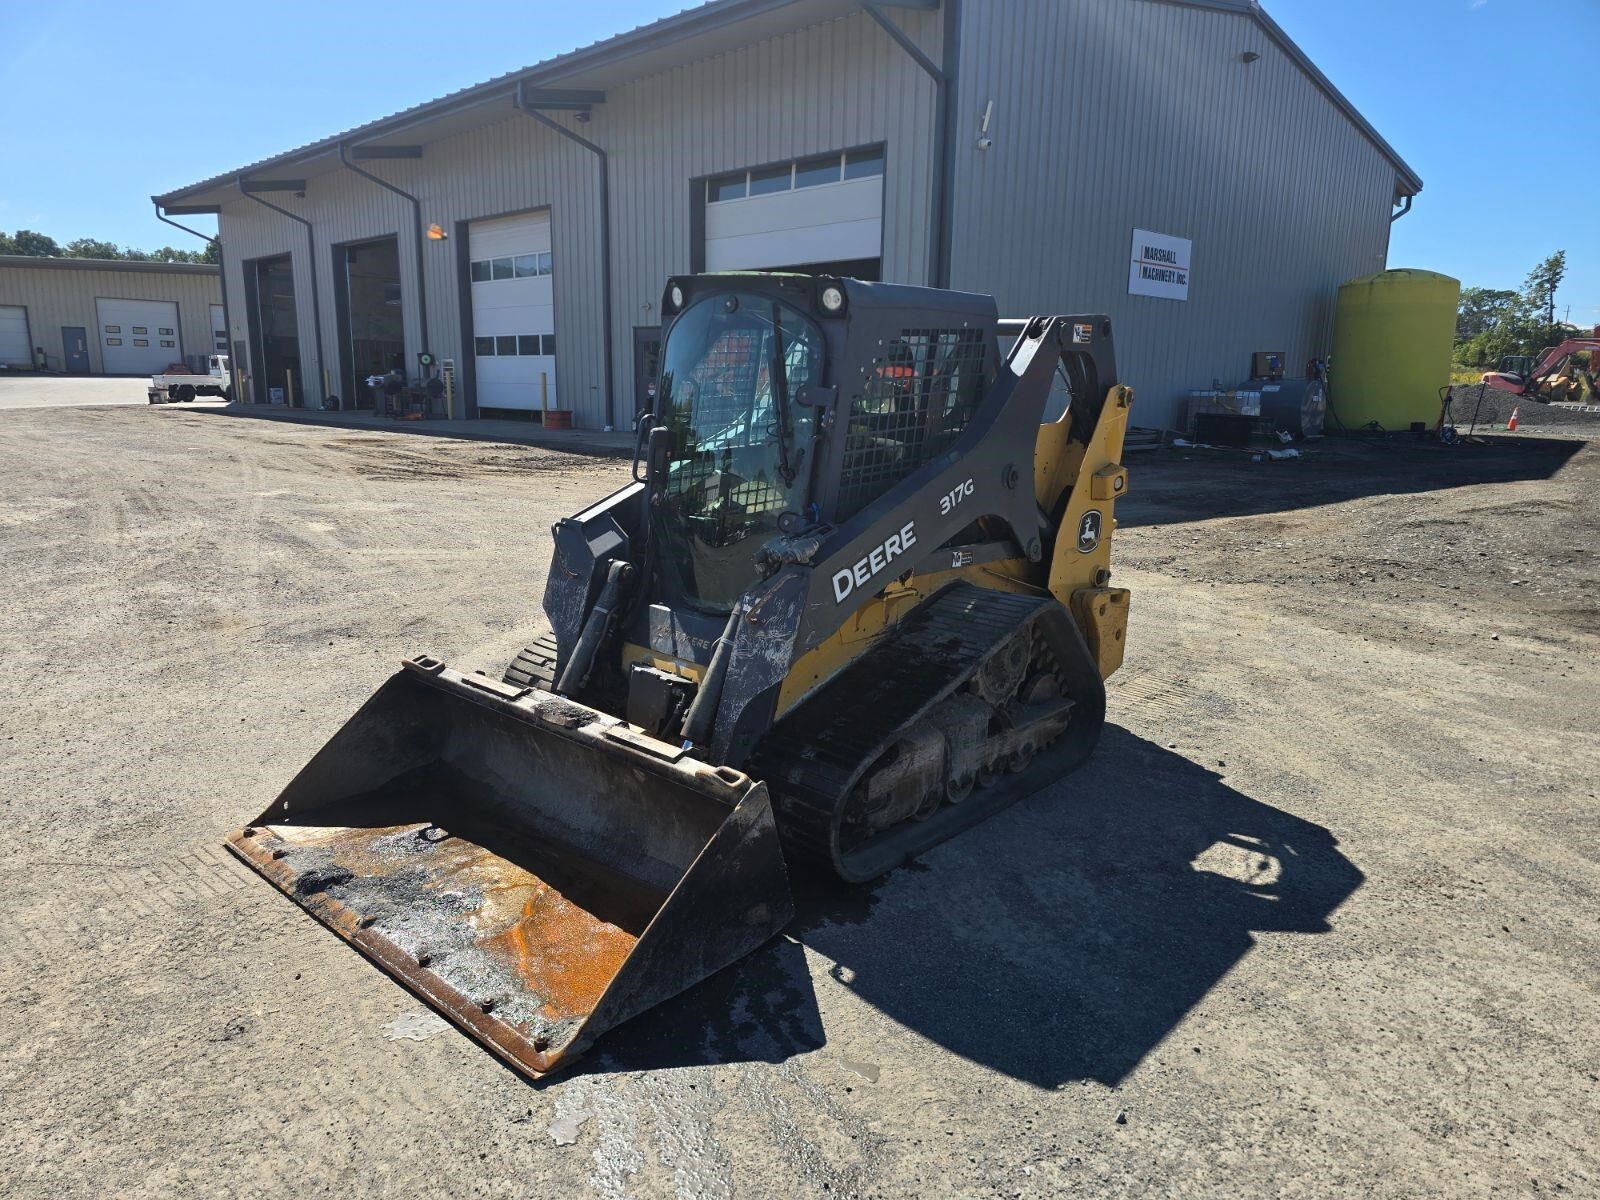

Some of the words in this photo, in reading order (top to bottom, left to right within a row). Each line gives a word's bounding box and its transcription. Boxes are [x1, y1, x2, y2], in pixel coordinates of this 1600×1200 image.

[1143, 246, 1177, 264] MARSHALL
[1142, 266, 1176, 283] MACHINERY
[939, 478, 974, 515] 317G
[832, 520, 917, 603] DEERE
